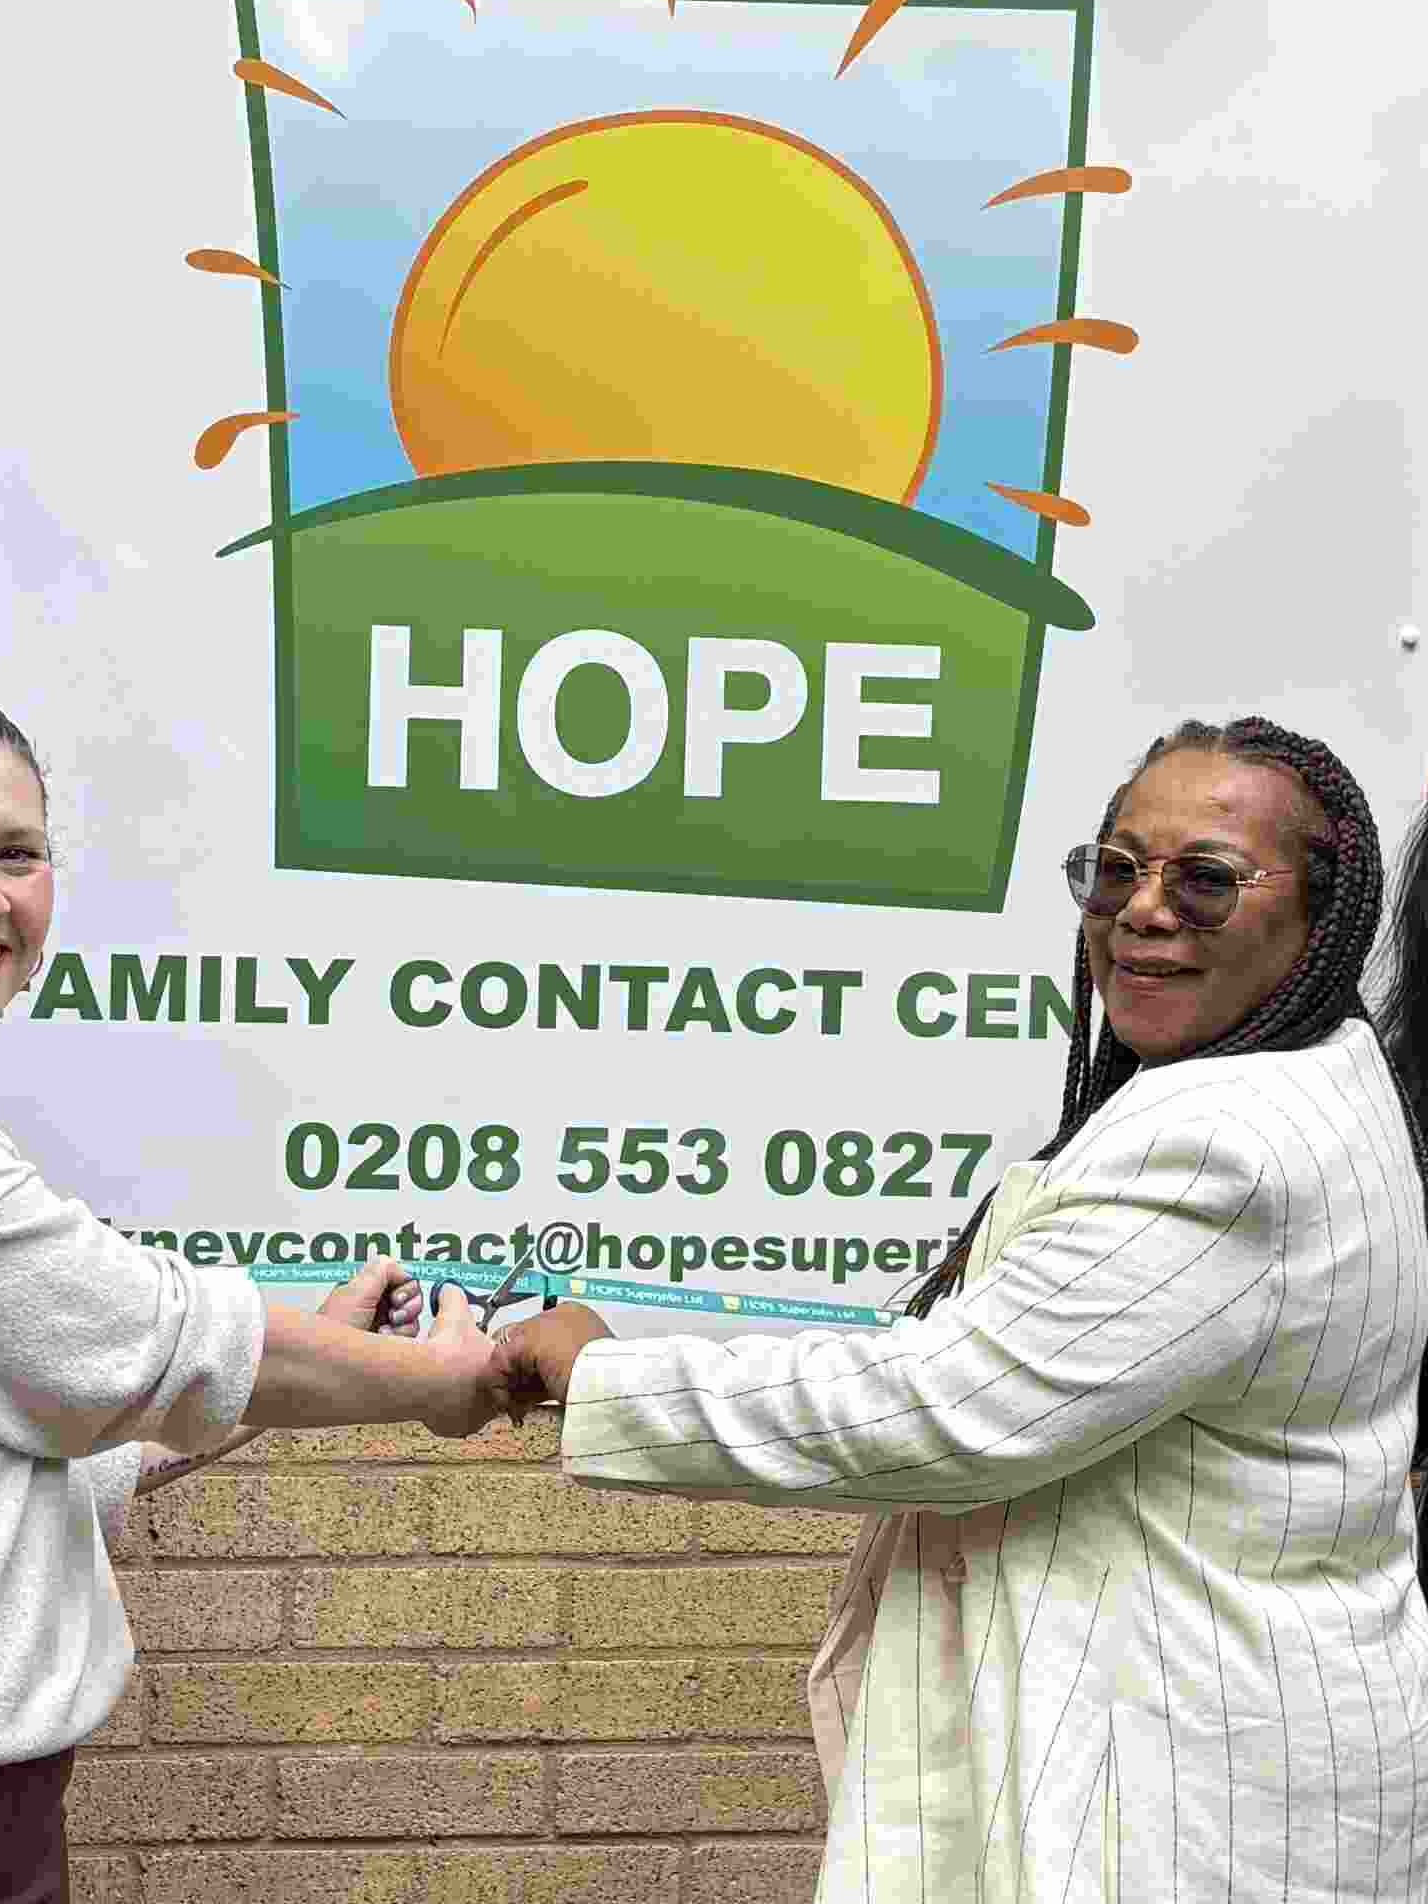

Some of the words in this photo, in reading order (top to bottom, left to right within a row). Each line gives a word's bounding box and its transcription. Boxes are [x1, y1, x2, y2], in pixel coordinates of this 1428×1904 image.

[367, 625, 942, 804] HOPE
[28, 952, 357, 1026] AMILY
[388, 959, 864, 1036] CONTACT
[895, 970, 1076, 1041] CEN
[283, 1121, 522, 1193] 0208
[556, 1126, 729, 1195] 553
[763, 1130, 993, 1199] 0827
